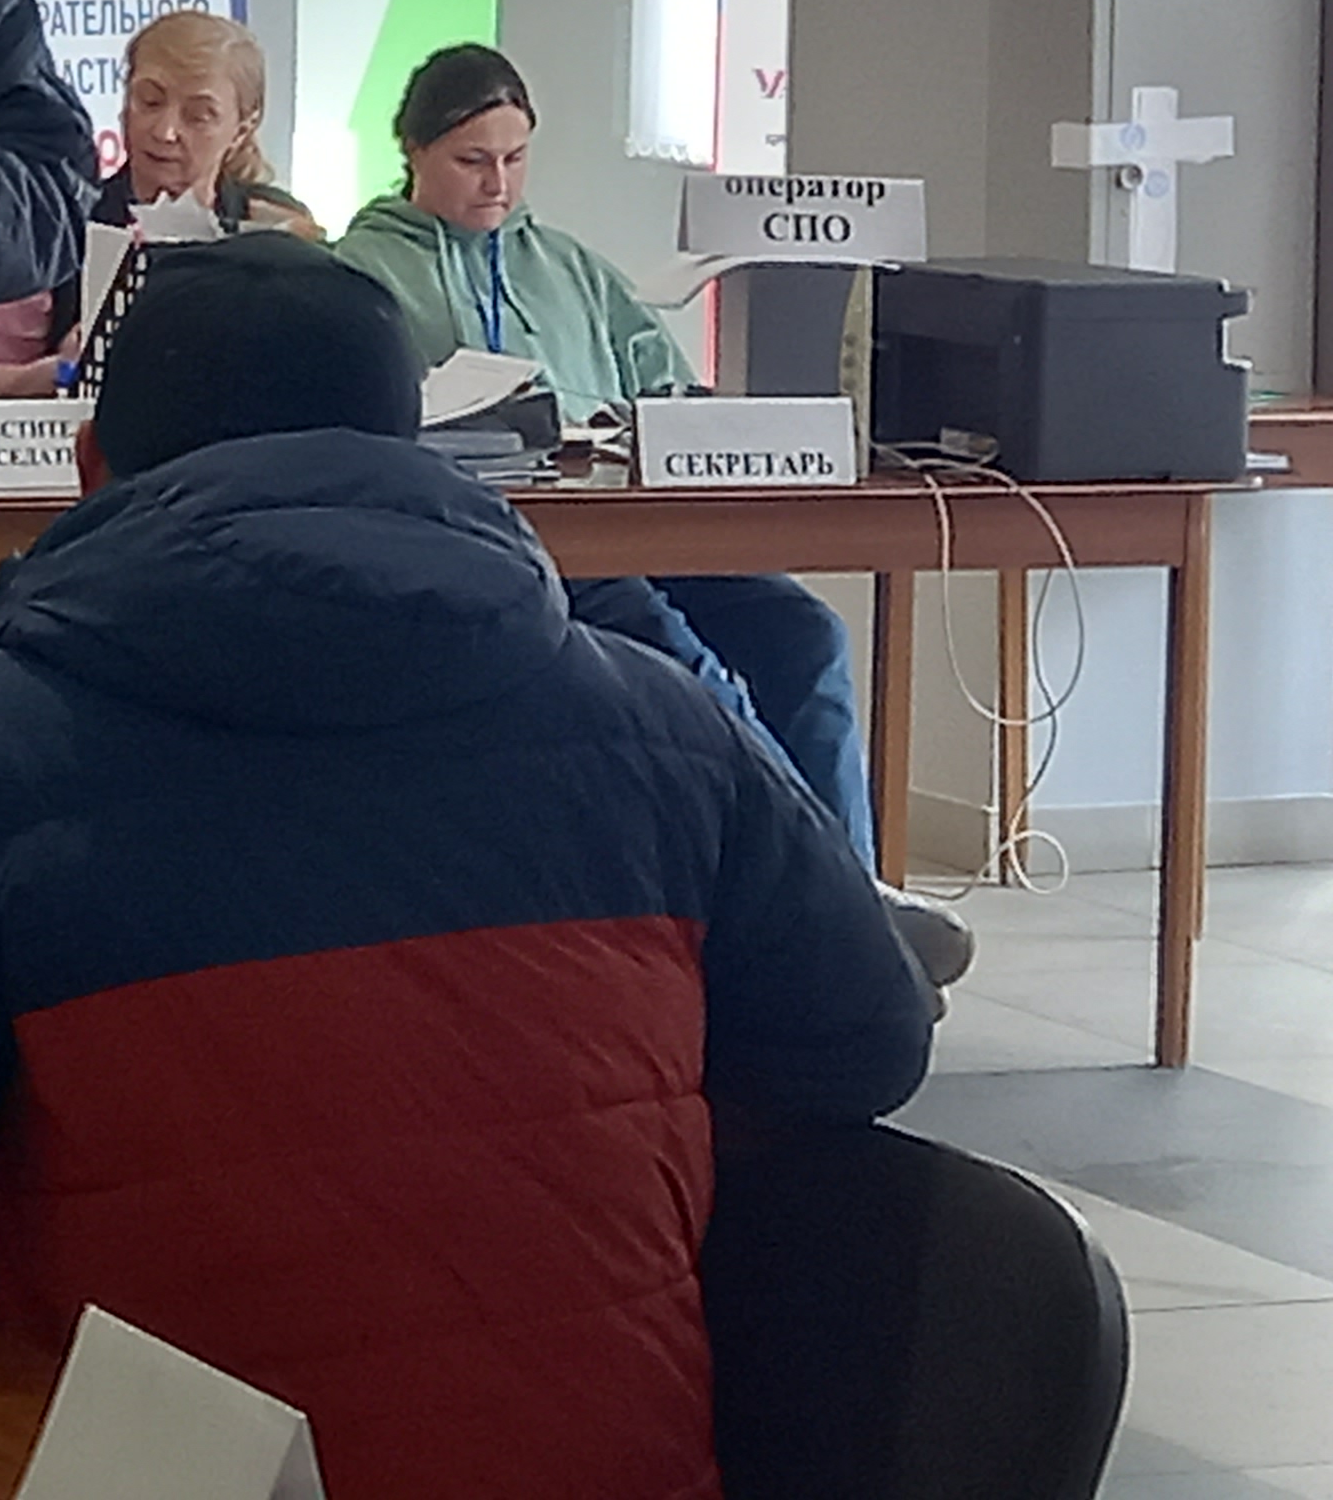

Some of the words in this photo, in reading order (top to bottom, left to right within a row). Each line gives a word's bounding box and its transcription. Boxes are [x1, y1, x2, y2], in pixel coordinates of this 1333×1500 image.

[60, 56, 126, 95] АСТК
[724, 175, 886, 207] оператор
[763, 212, 851, 243] СПО
[665, 451, 835, 477] СЕКРЕТАРЬ
